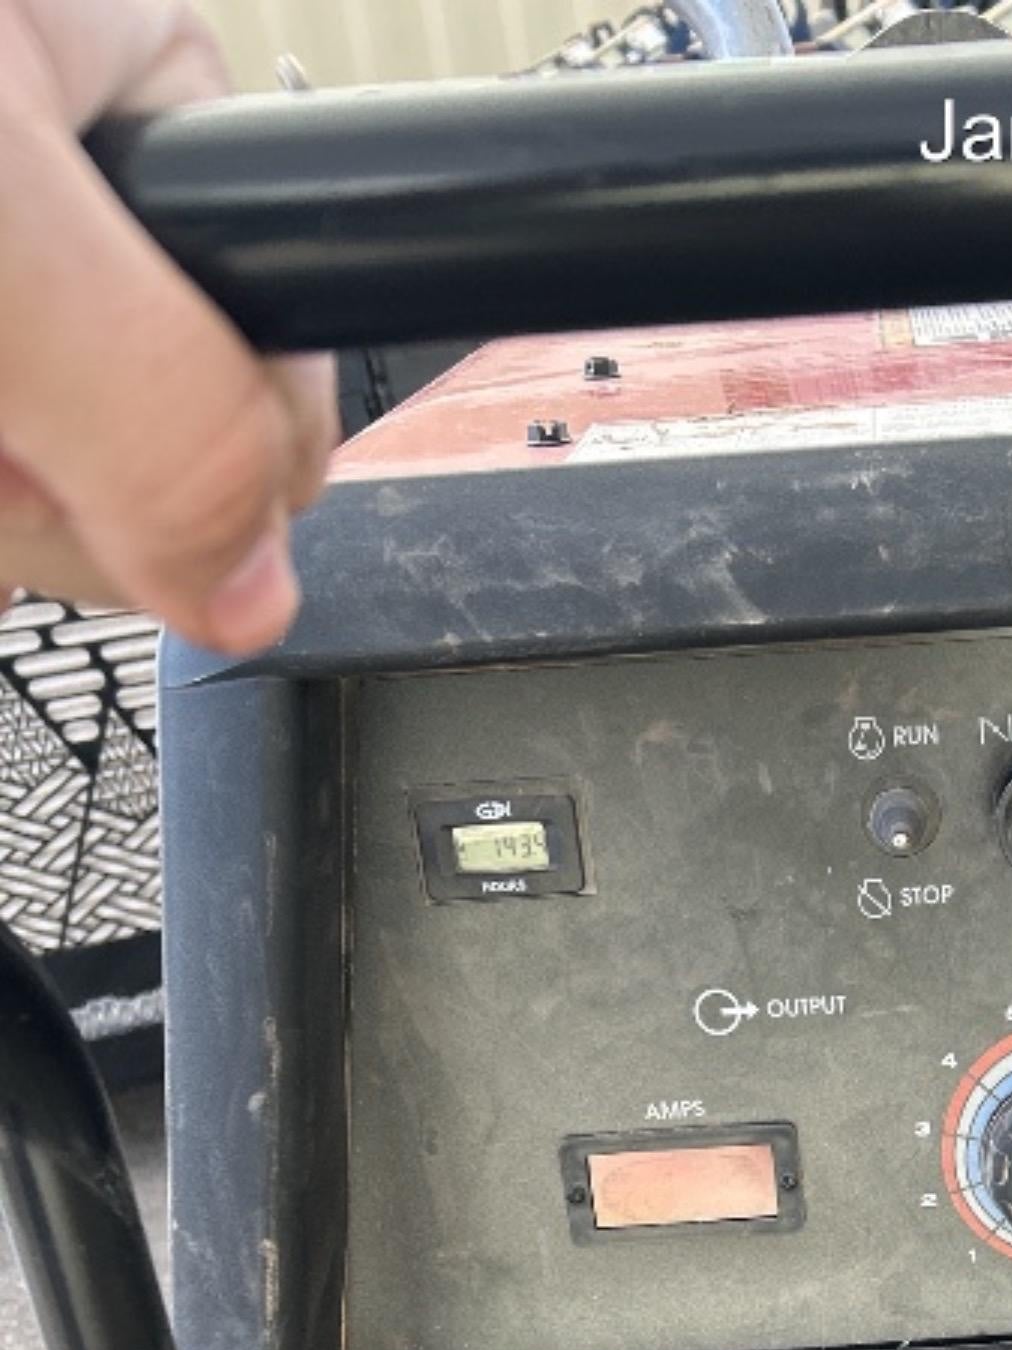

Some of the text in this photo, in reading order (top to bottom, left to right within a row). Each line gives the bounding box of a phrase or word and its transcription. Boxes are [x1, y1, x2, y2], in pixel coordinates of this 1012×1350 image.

[892, 725, 939, 746] RUN
[900, 885, 955, 907] STOP
[766, 995, 847, 1018] OUTPUT
[941, 1052, 958, 1068] 4
[644, 1100, 706, 1121] AMPS
[914, 1121, 931, 1138] 3
[920, 1193, 937, 1208] 2
[968, 1249, 978, 1264] 1
